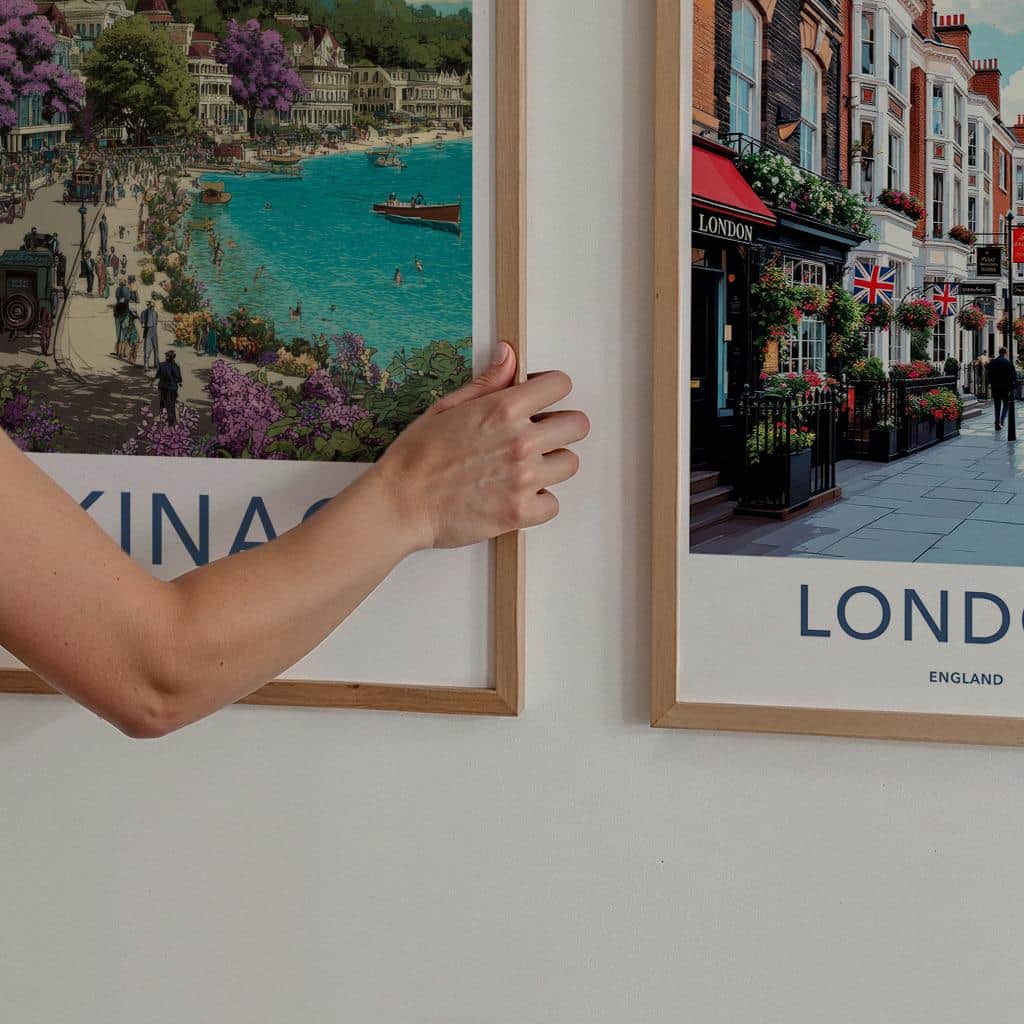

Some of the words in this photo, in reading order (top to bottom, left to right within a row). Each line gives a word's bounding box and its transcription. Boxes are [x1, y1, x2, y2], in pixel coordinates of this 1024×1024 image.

[698, 213, 753, 242] LONDON
[800, 583, 1024, 644] LOND
[929, 670, 1004, 686] ENGLAND
